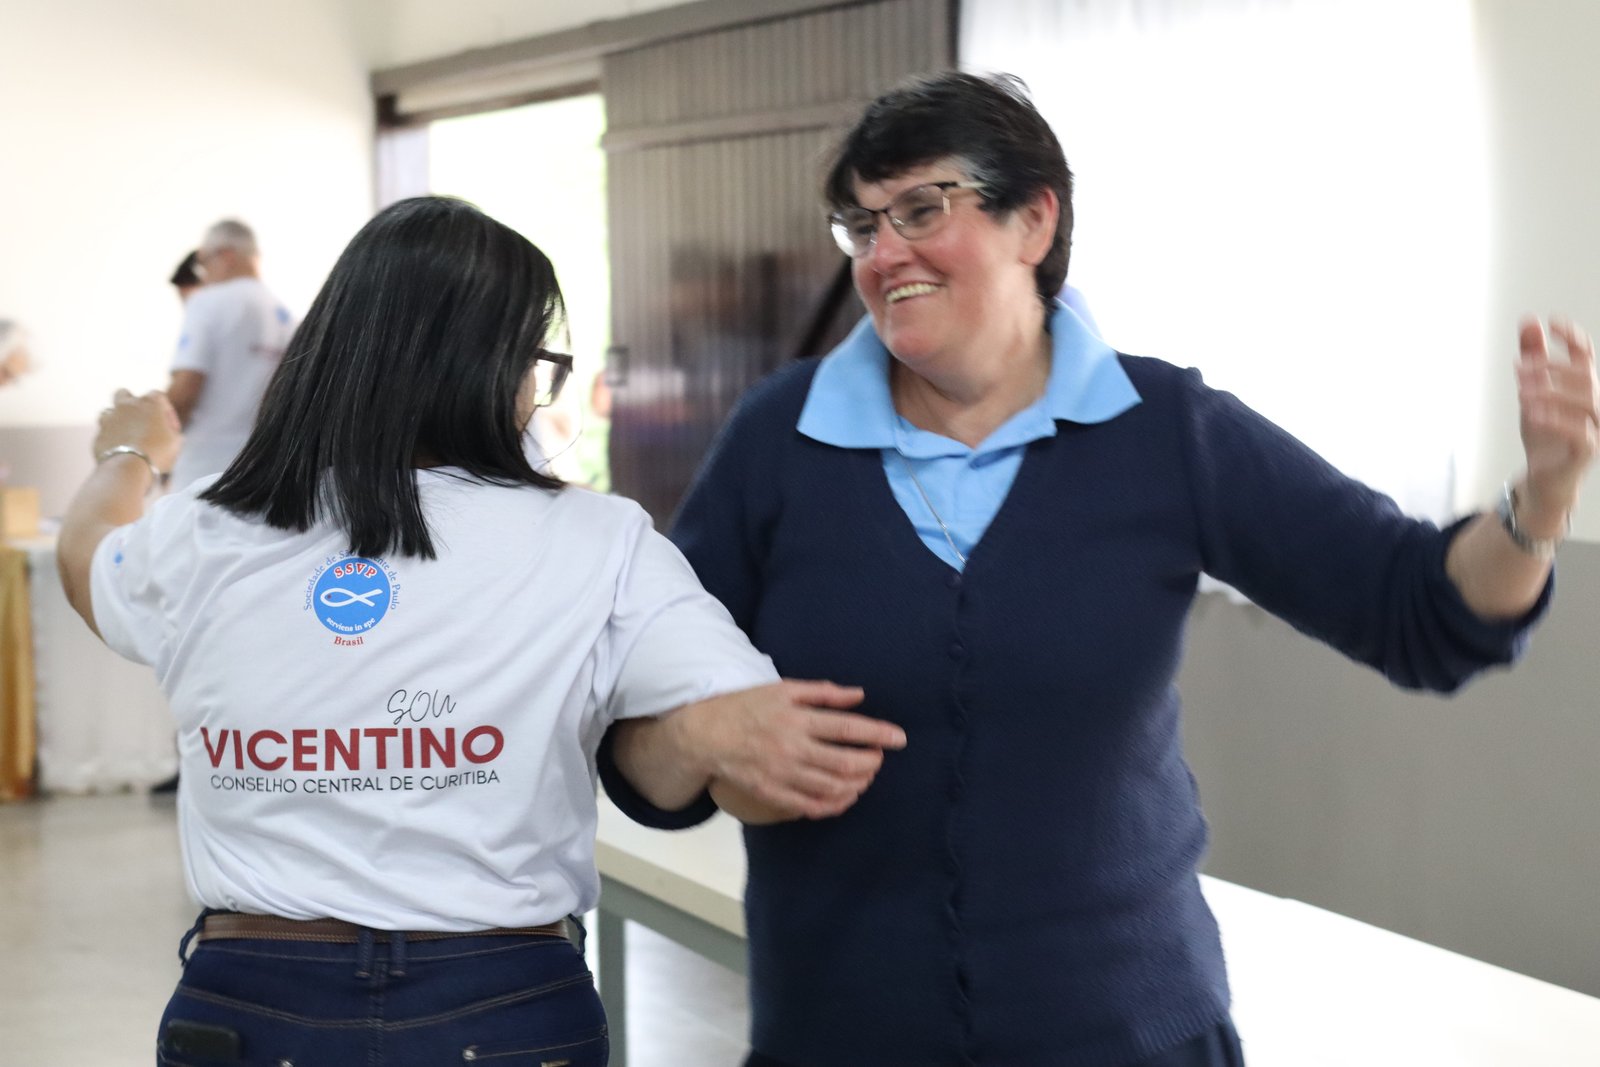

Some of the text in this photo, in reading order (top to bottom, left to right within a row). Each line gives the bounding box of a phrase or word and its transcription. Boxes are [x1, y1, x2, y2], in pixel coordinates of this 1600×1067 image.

[326, 556, 336, 566] de
[334, 563, 377, 579] SSVP
[388, 570, 398, 581] de
[304, 565, 325, 611] Sociedade
[390, 584, 400, 610] Paulo
[326, 617, 353, 632] serviens
[364, 617, 376, 628] spe
[334, 636, 364, 646] Brasil
[200, 725, 504, 772] VICENTINO
[210, 769, 500, 794] CONSELHO CENTRAL DE CURITIBA
